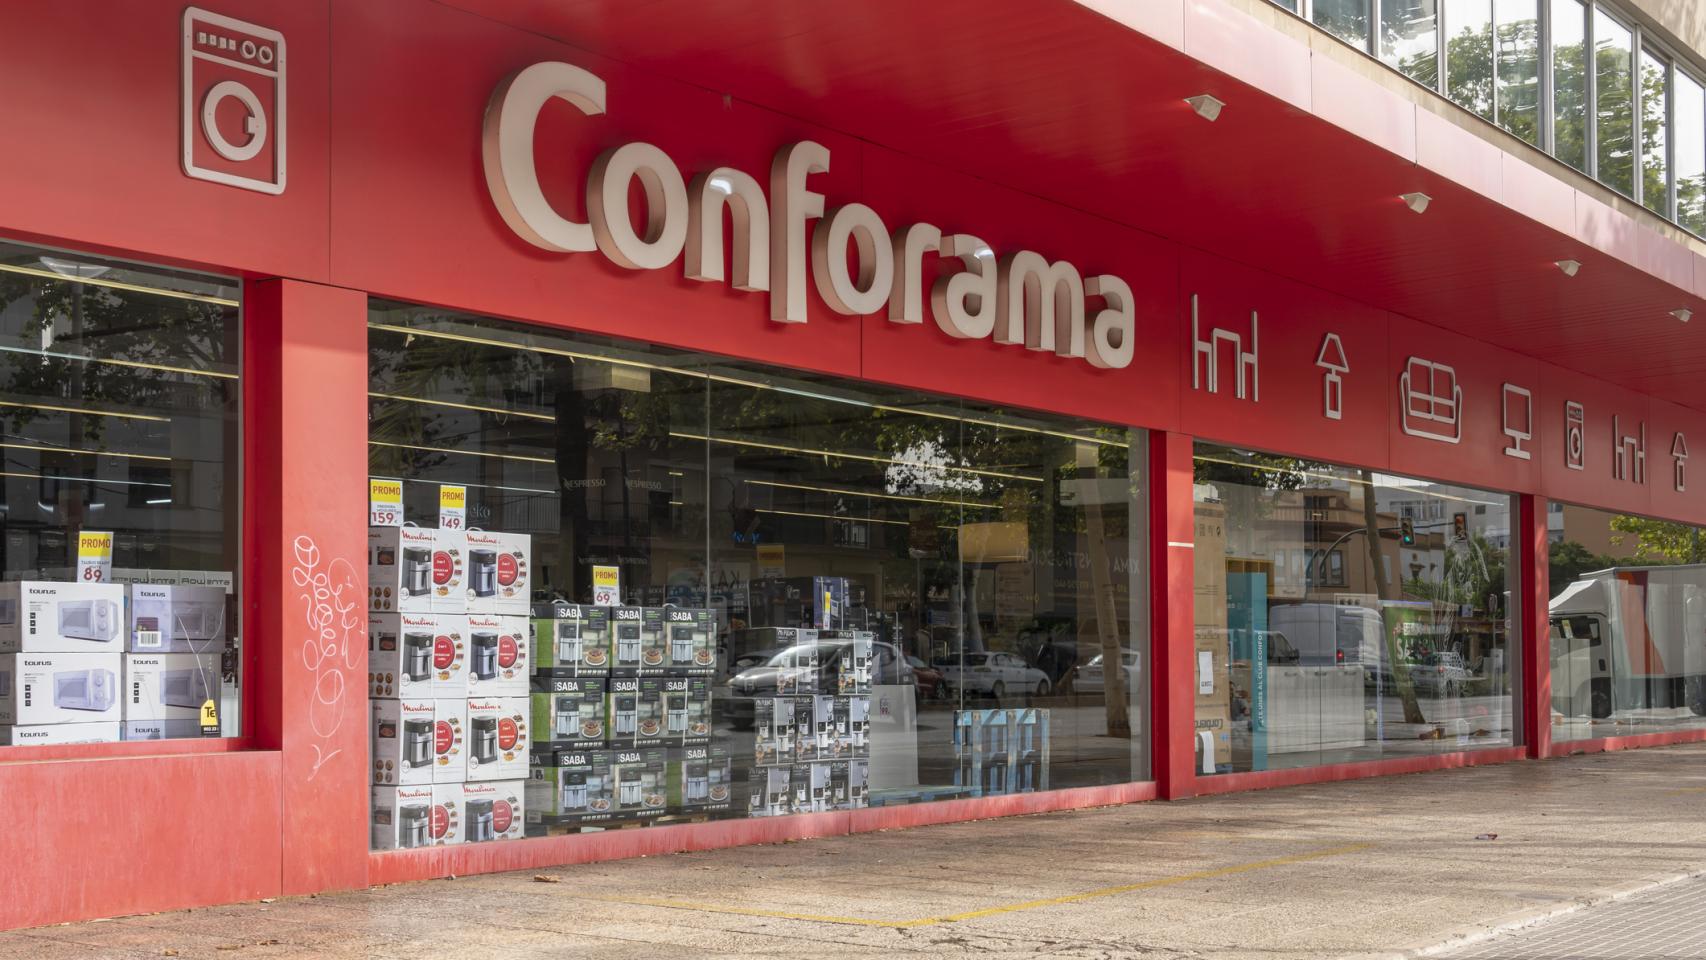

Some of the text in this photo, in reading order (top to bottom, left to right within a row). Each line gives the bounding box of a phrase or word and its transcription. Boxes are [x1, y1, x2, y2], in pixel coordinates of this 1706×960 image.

[482, 60, 1135, 370] Conforama
[564, 478, 606, 490] NESPRESSO
[373, 485, 401, 496] PROMO
[442, 491, 465, 501] PROMO
[466, 503, 491, 519] eko
[371, 511, 394, 524] 159
[441, 516, 460, 529] 149
[81, 538, 111, 549] PROMO
[83, 567, 103, 583] 89
[595, 571, 617, 580] PROMO
[560, 607, 582, 618] SABA
[618, 610, 640, 620] SABA
[672, 611, 692, 621] SABA
[469, 616, 500, 627] Mouline
[556, 681, 579, 692] SABA
[616, 681, 638, 692] SABA
[668, 680, 688, 691] SABA
[620, 753, 641, 763] SABA
[687, 750, 707, 760] SABA
[563, 756, 586, 766] SABA
[398, 789, 432, 798] Moulinex
[463, 784, 496, 793] Moulinex
